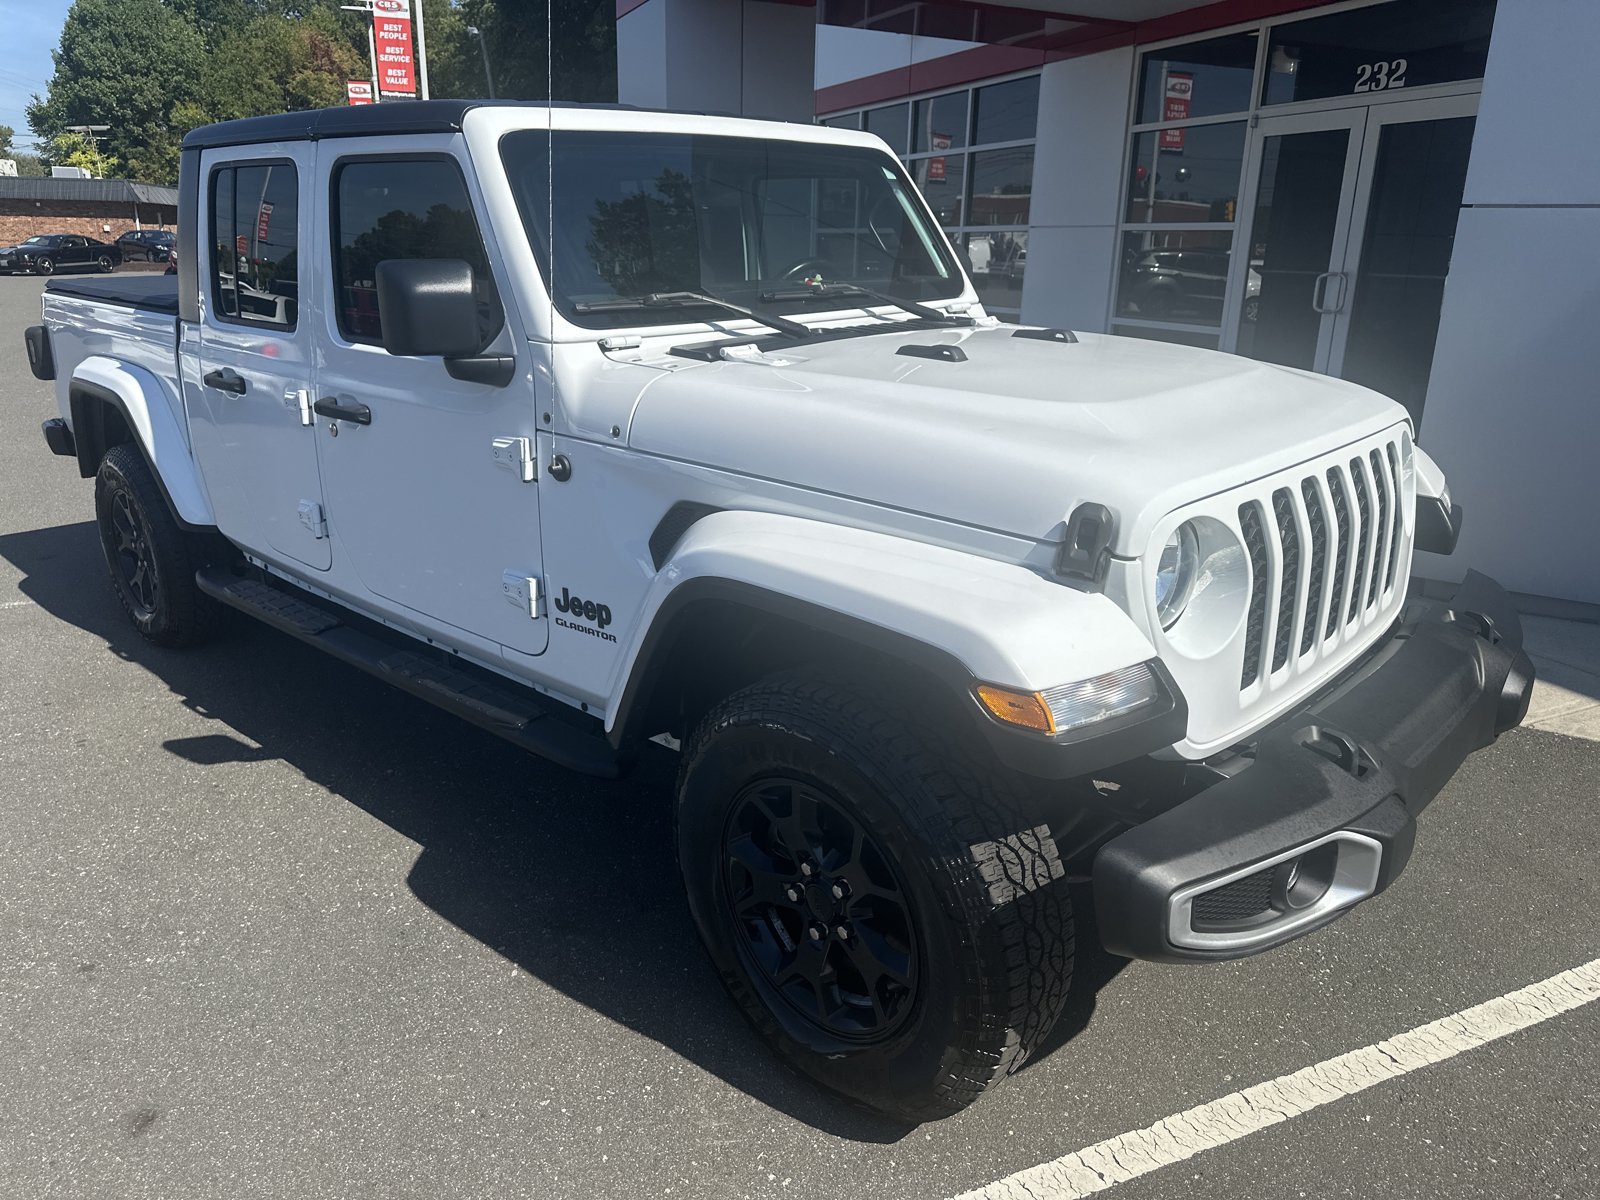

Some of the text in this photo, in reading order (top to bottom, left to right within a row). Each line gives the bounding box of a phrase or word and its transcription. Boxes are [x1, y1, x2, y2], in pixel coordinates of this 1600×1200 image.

[379, 32, 407, 40] PEOPLE
[379, 54, 410, 63] SERVICE
[385, 77, 408, 85] VALUE
[1354, 59, 1407, 93] 232
[554, 587, 612, 629] Jeep
[555, 617, 617, 644] GLADIATOR
